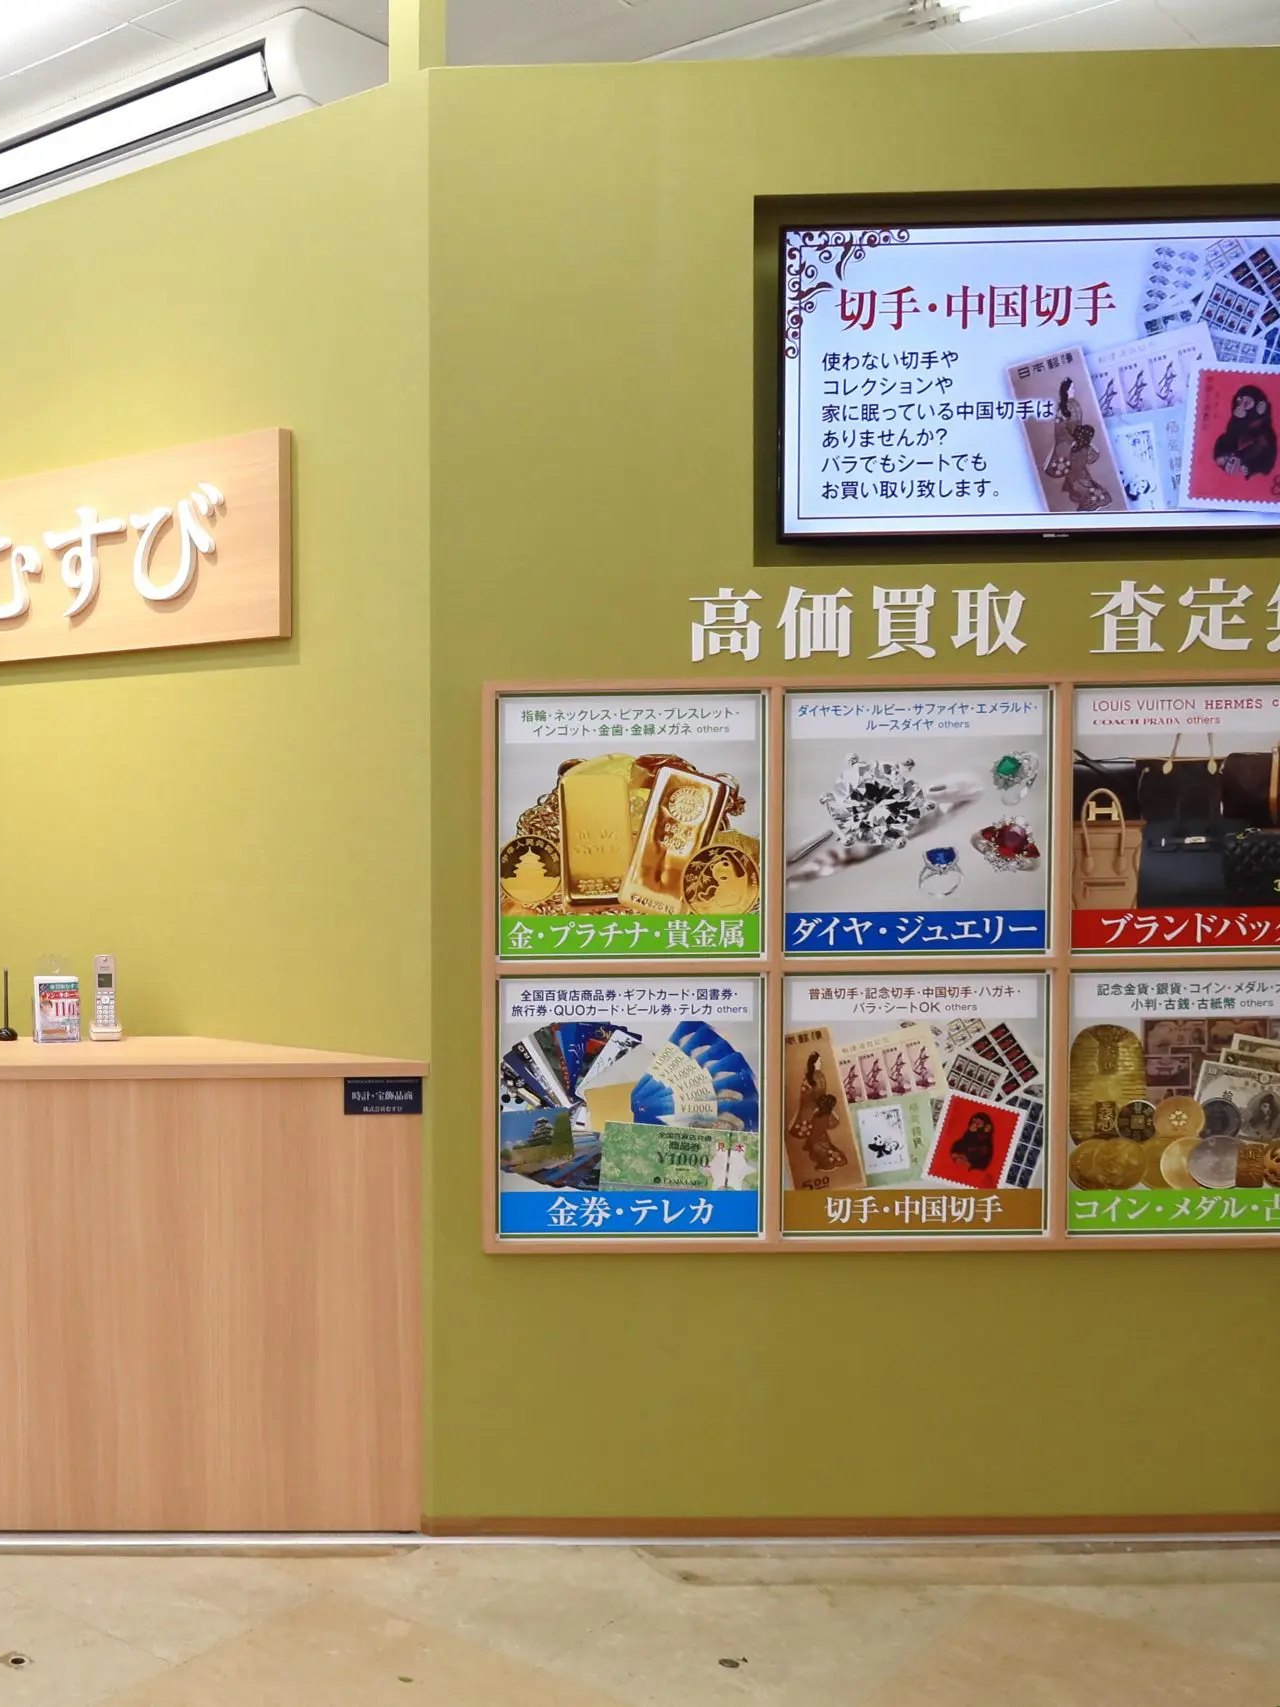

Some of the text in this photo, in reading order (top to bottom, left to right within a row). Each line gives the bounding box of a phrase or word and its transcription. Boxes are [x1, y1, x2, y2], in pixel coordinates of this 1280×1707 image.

[835, 281, 1117, 332] 切手・中国切手
[821, 350, 959, 370] 使わない切手や
[822, 376, 953, 397] コレクションや
[821, 400, 1054, 422] 家に眠っている中国切手は
[821, 453, 987, 474] バラでもシートでも
[821, 478, 1001, 500] お買い取り致します。
[690, 578, 1280, 662] 高価買取 査定
[1092, 700, 1132, 712] LOUIS
[1136, 699, 1196, 711] VUITTON
[533, 723, 730, 737] インゴット・金歯・金縁メガネ others
[865, 719, 970, 731] ルースダイヤ others
[1093, 715, 1221, 726] COACH PRADA others
[507, 919, 745, 950] 金・プラチナ・貴金属
[792, 915, 1038, 946] ダイヤ・ジュエリー
[1101, 912, 1280, 945] ブランドバッ
[511, 1004, 748, 1018] 旅行券・QUOカード・ビール券・テレカ others
[852, 1001, 978, 1014] バラ・シートOK others
[1240, 1000, 1274, 1008] others
[546, 1196, 714, 1228] 金券・テレカ
[824, 1195, 1003, 1224] 切手・中国切手
